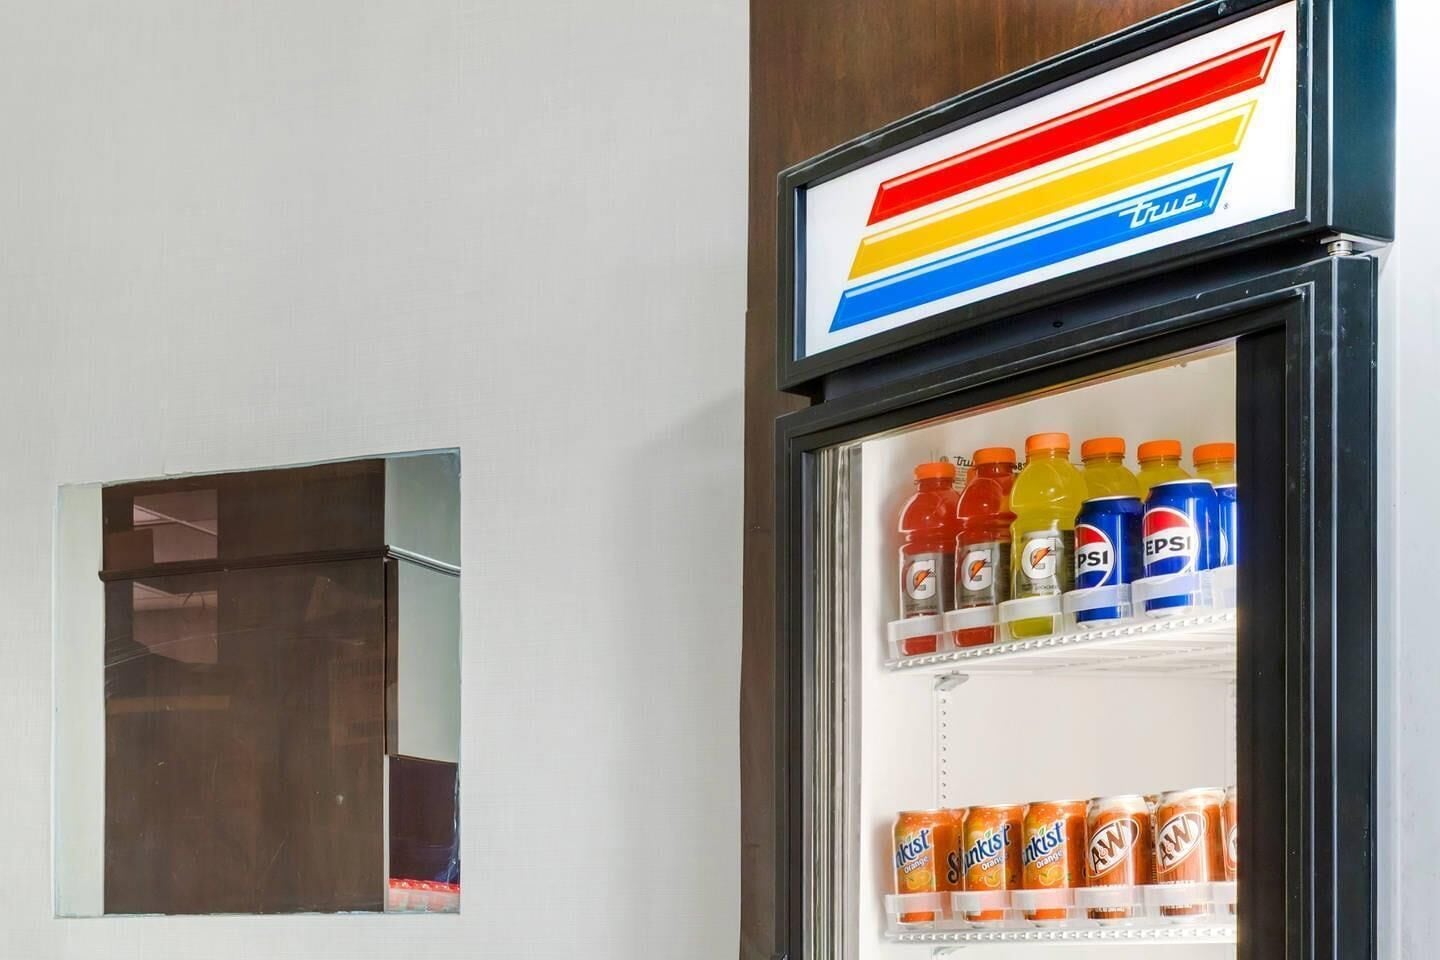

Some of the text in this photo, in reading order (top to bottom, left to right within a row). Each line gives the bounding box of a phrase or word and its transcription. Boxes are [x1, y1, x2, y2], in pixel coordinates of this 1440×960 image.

[1077, 550, 1108, 568] PSI
[1145, 536, 1191, 556] EPSI
[895, 828, 930, 868] nkist
[963, 823, 1010, 873] unkist
